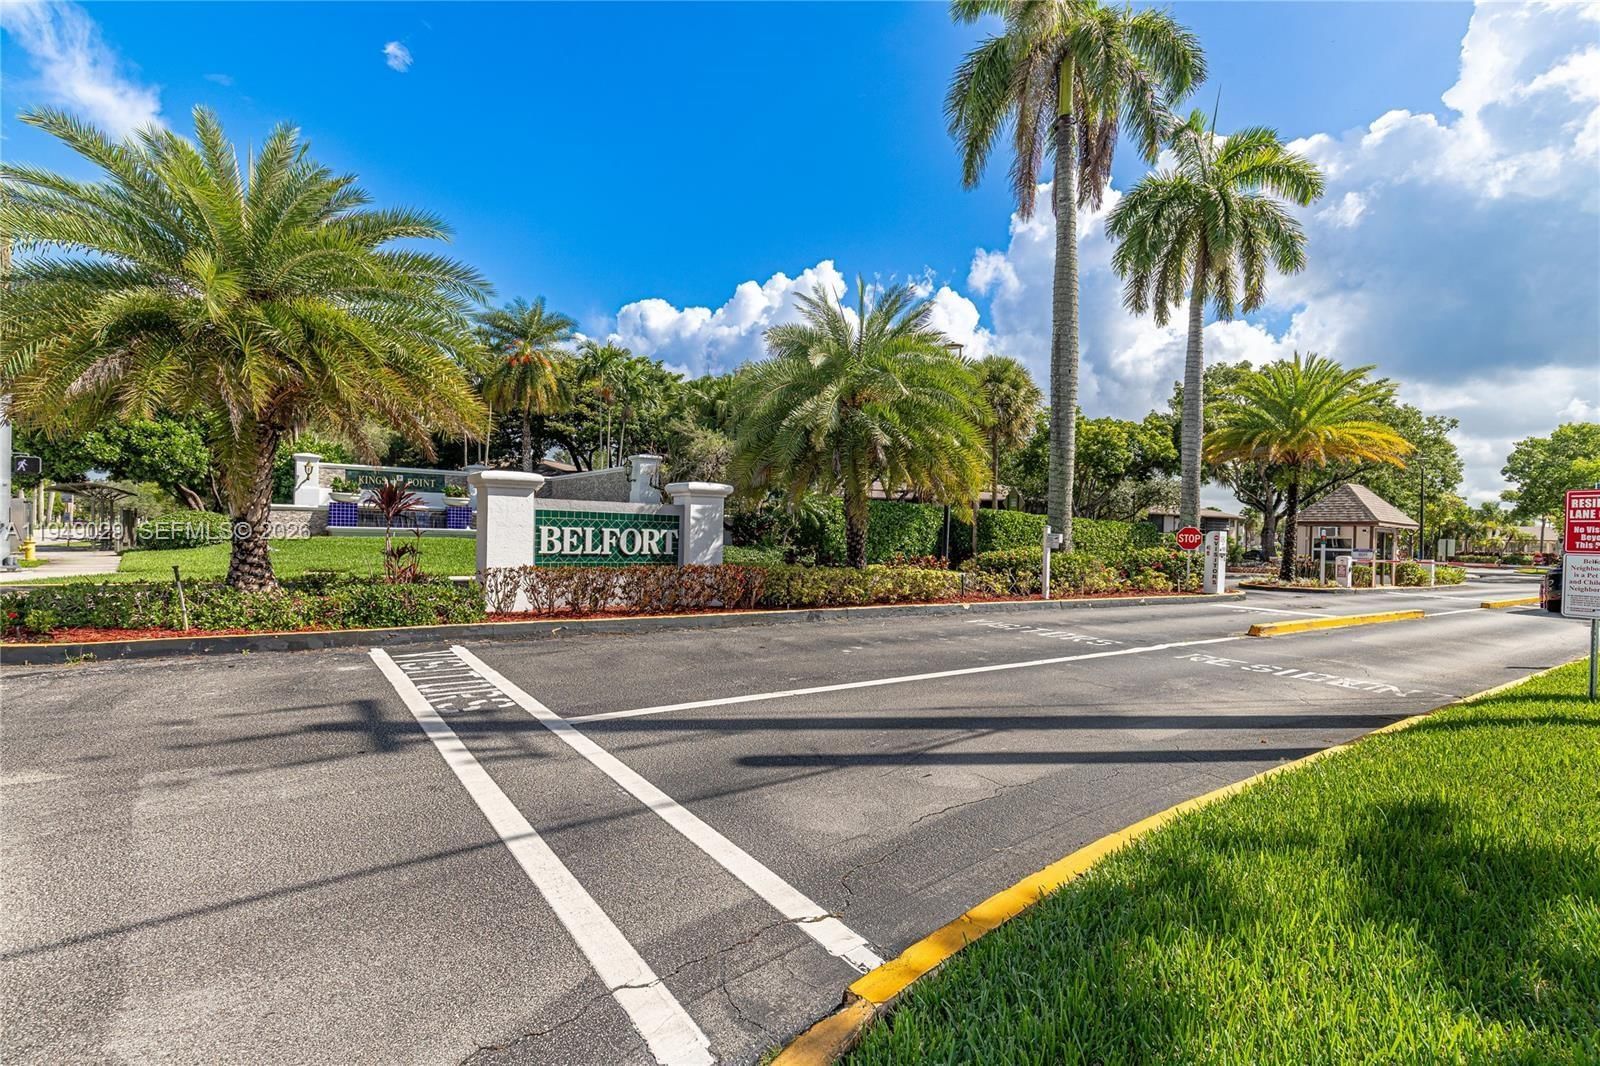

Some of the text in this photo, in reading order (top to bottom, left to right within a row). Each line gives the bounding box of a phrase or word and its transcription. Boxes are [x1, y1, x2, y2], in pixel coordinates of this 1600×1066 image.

[358, 475, 436, 488] KINGS POINT
[1569, 509, 1596, 519] LANE
[1573, 526, 1585, 534] No
[538, 525, 679, 556] BELFORT
[1178, 533, 1201, 544] STOP
[1575, 541, 1593, 549] This
